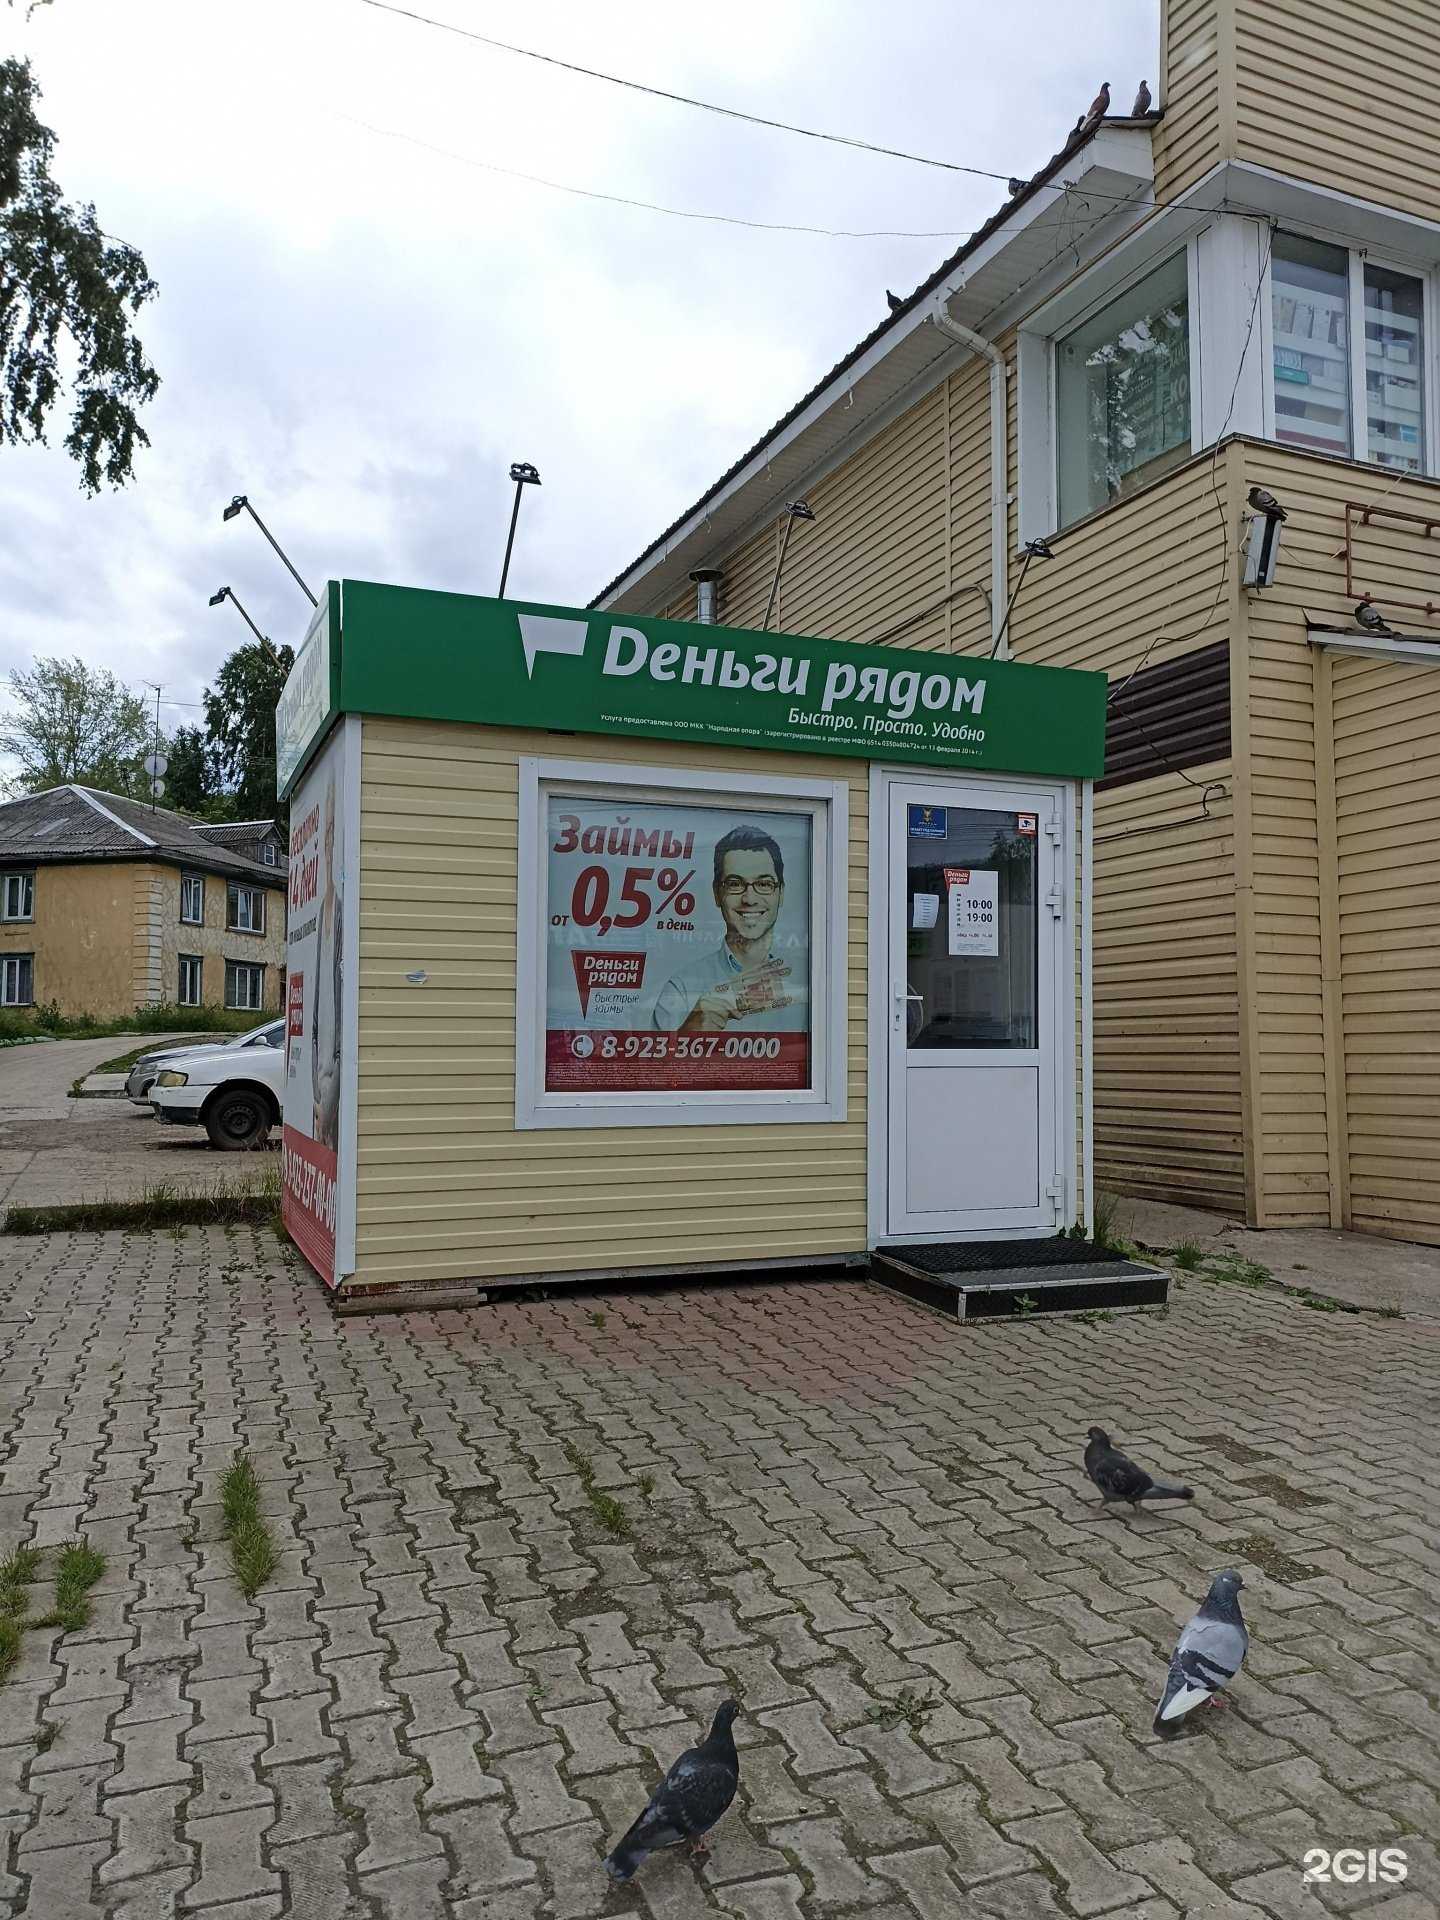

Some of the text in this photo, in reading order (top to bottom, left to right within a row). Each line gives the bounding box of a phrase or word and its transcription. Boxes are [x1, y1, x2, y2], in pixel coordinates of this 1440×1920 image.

[821, 662, 987, 719] рядом
[600, 714, 623, 723] Услуга
[624, 716, 673, 727] предоставлена
[674, 720, 689, 728] ООО
[788, 707, 985, 742] Быстро. Просто. Удобно
[553, 814, 696, 859] Займы
[551, 865, 697, 936] от 0,5%
[966, 899, 993, 910] 10:00
[656, 918, 695, 931] в день
[966, 912, 993, 923] 19:00
[588, 971, 637, 985] рядом
[601, 1035, 781, 1058] 8-923-367-0000
